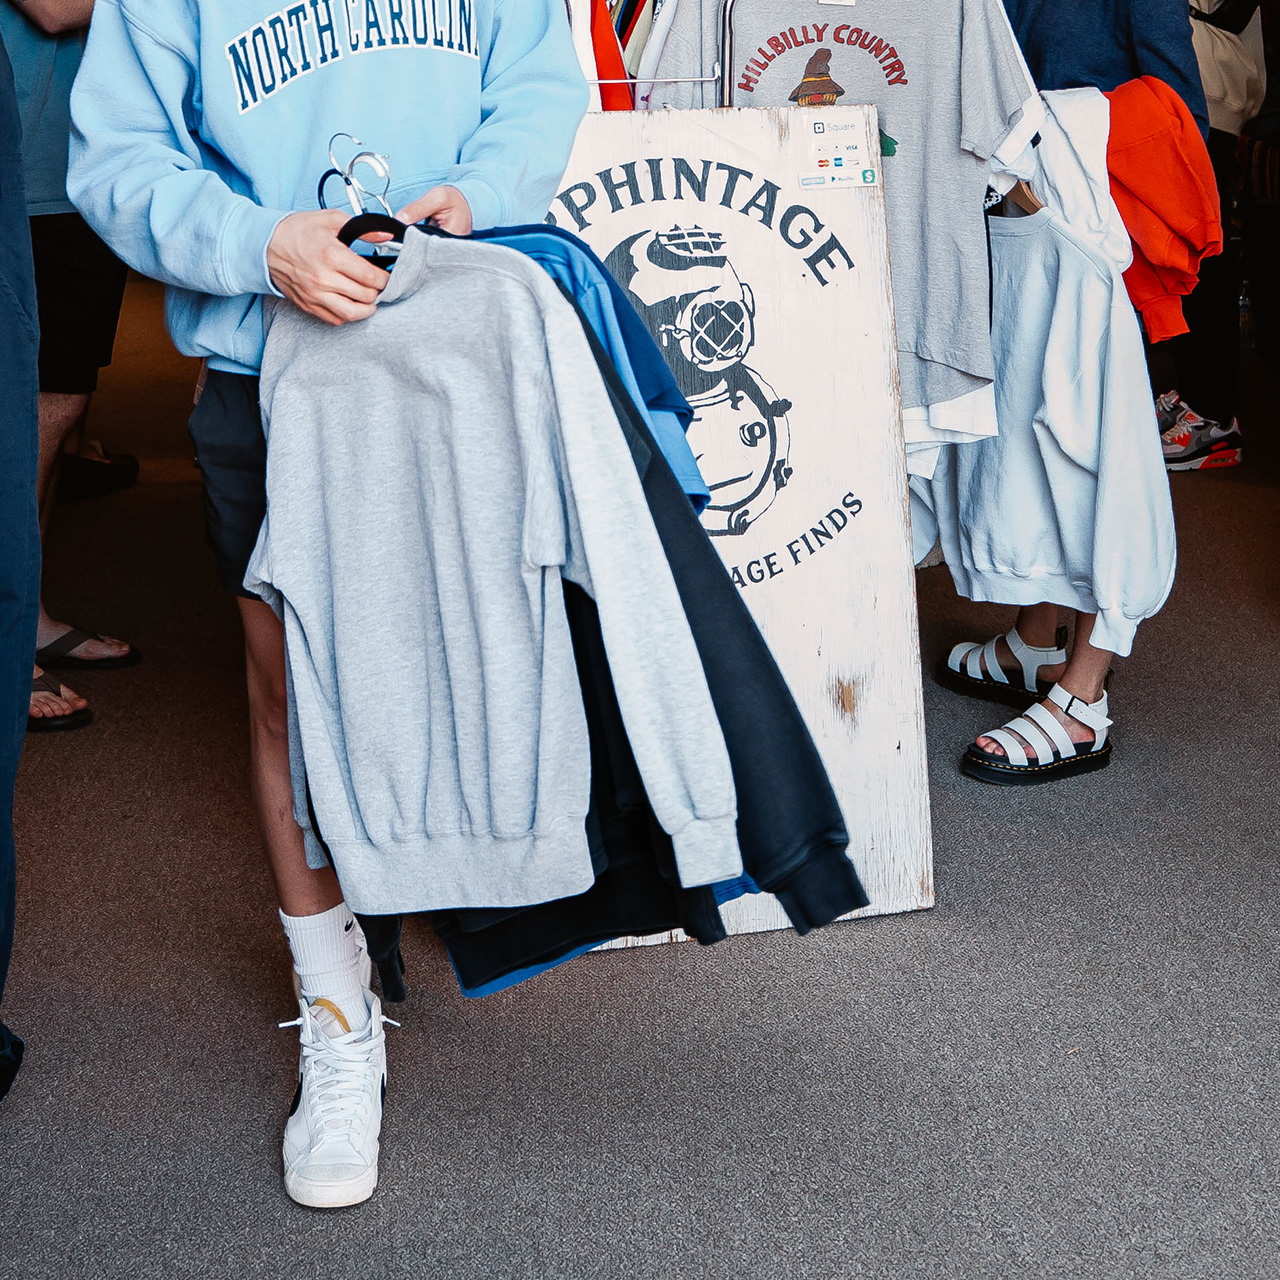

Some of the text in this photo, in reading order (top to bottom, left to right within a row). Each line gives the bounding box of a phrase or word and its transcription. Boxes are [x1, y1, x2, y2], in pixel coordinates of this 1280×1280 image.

[737, 23, 908, 93] HILLBILLY COUNTRY
[827, 123, 855, 131] Square
[544, 158, 855, 287] PHINTAGE
[786, 491, 863, 566] FINDS
